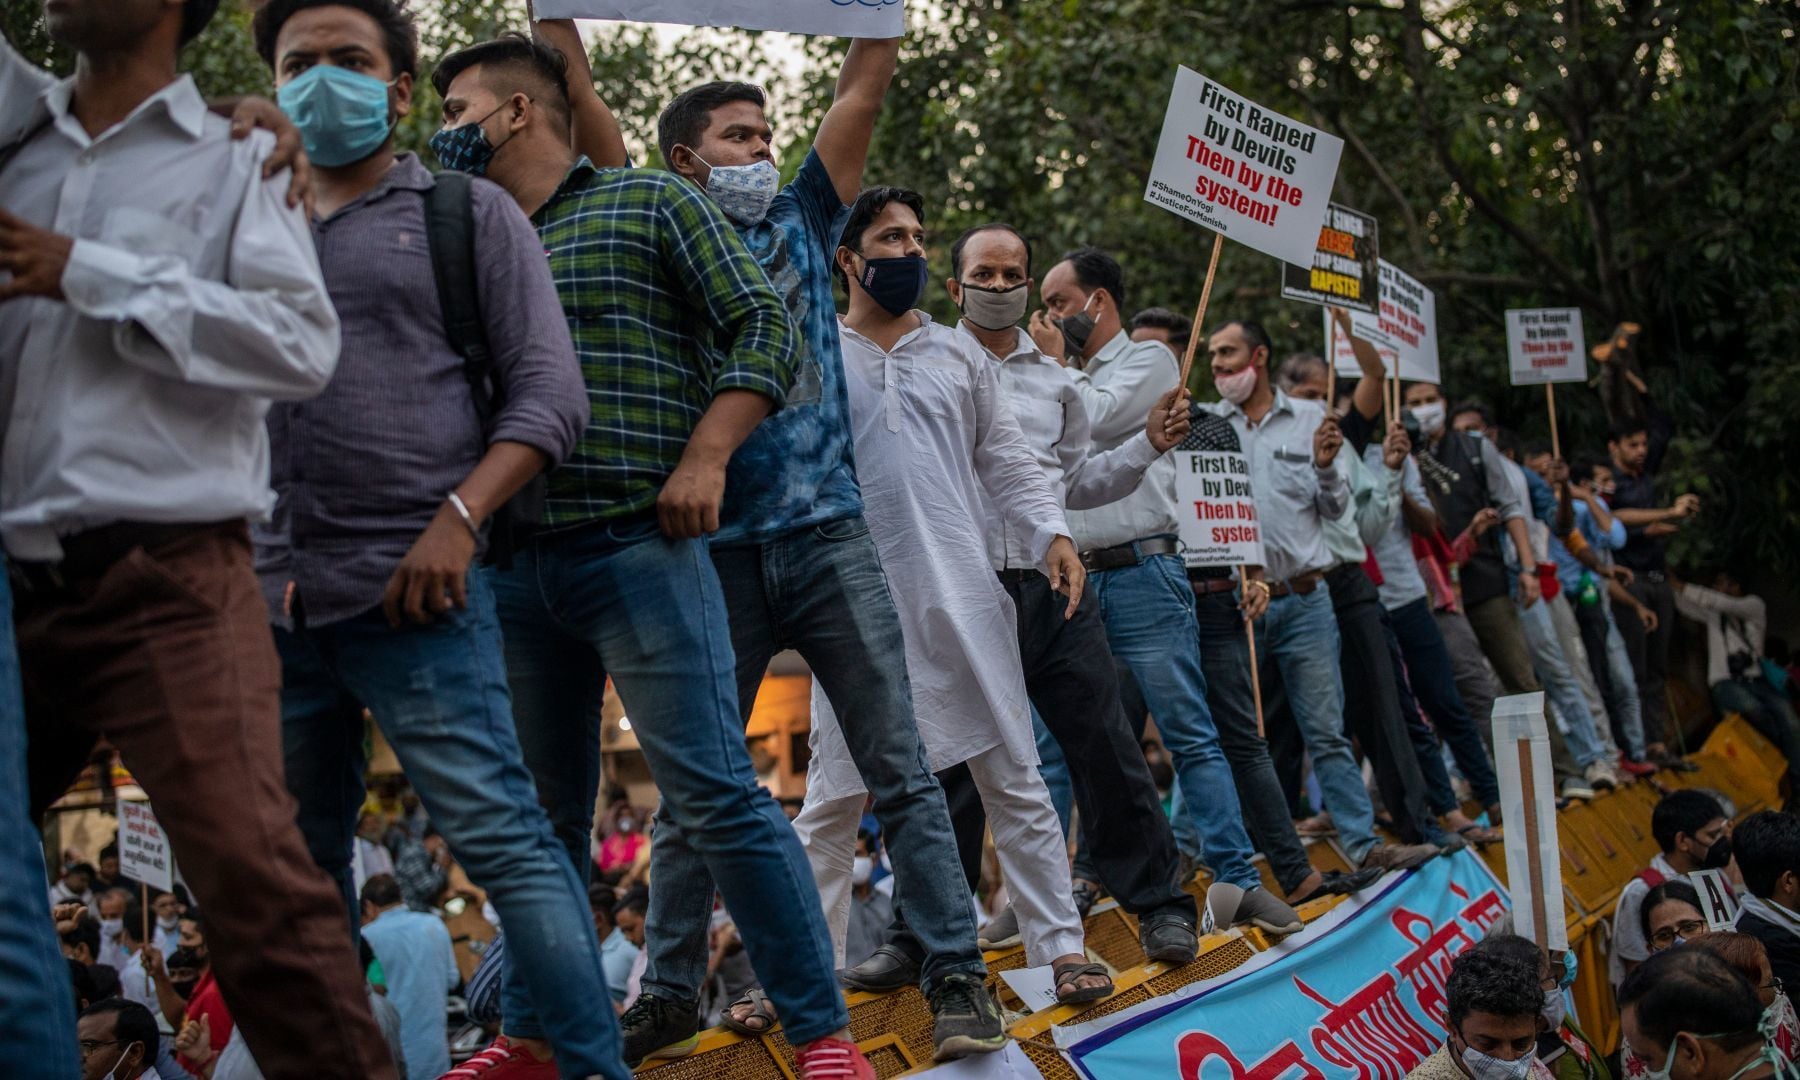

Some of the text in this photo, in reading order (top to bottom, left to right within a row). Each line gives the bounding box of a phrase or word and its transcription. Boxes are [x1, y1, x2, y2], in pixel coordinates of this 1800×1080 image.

[1199, 81, 1317, 155] First Raped
[1203, 114, 1297, 175] by Devils
[1185, 134, 1303, 207] Then by the
[1149, 191, 1228, 232] #JusticeForManisha
[1152, 179, 1214, 214] #ShameOnYogi
[1195, 175, 1280, 227] system!
[1310, 268, 1360, 299] RAPISTS!
[1191, 455, 1226, 474] First
[1202, 478, 1221, 499] by
[1193, 500, 1253, 521] Then by
[1184, 545, 1231, 555] ShameOnYogi
[1185, 555, 1245, 564] JusticeForManisha
[1702, 874, 1730, 923] A
